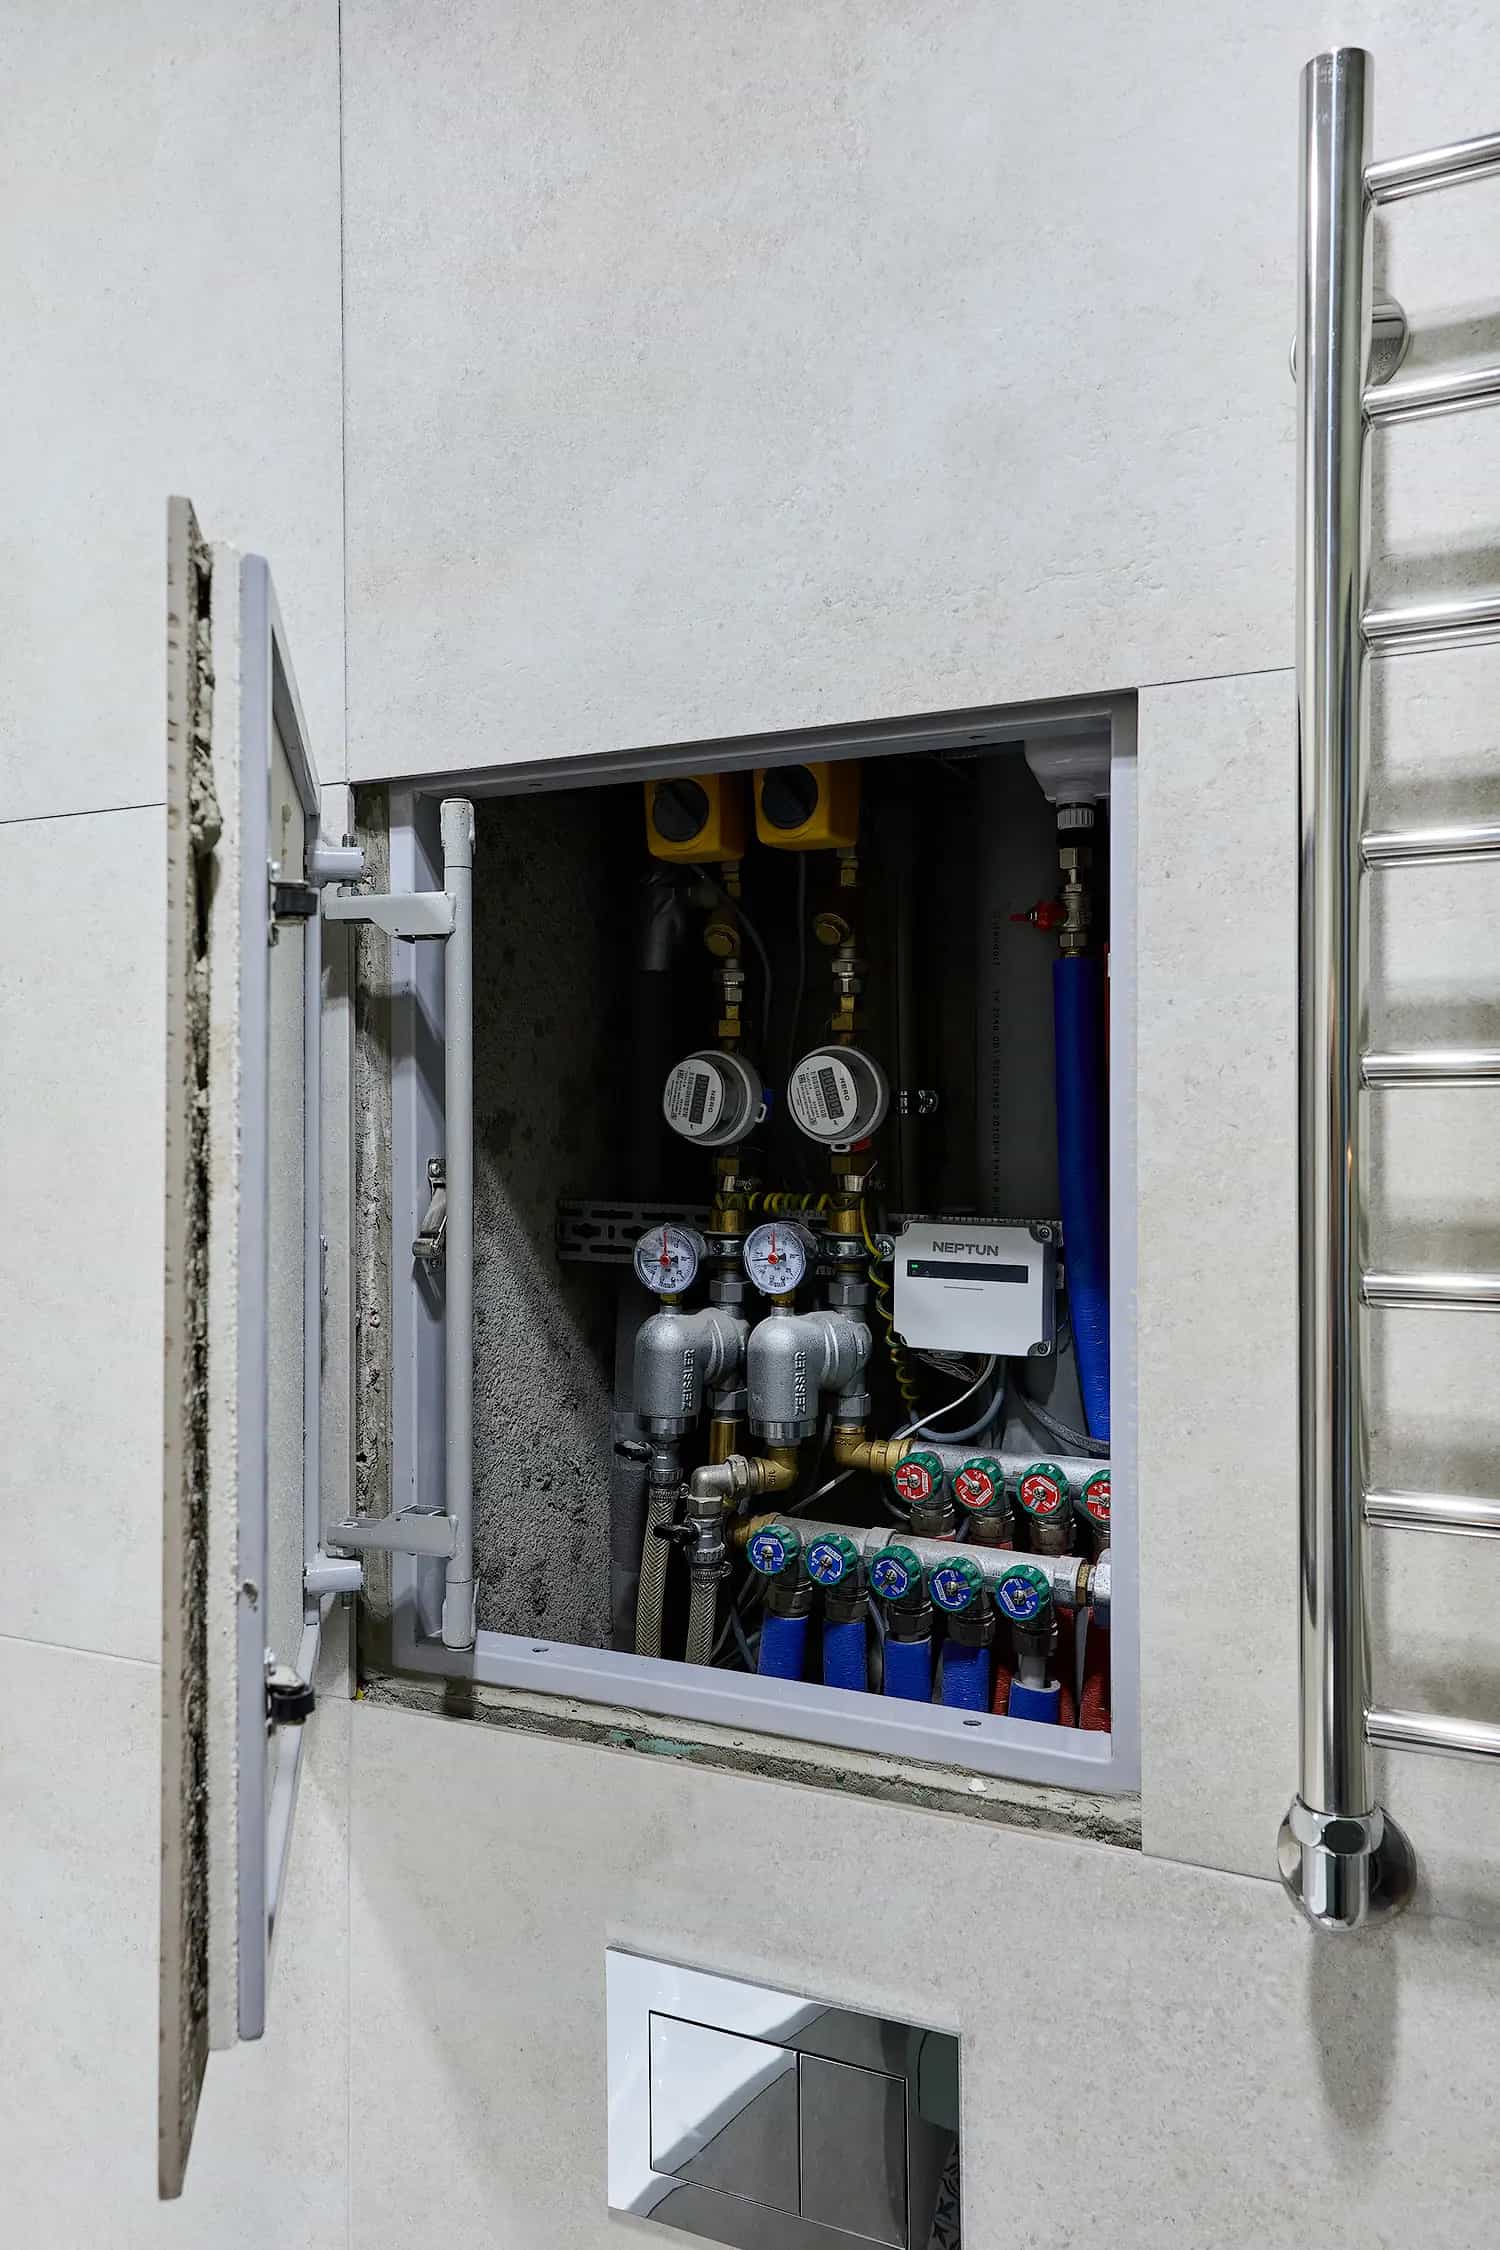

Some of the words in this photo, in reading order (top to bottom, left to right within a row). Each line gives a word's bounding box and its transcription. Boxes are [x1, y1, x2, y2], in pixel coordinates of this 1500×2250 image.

[932, 1240, 999, 1257] NEPTUN
[681, 1349, 696, 1411] ZEISSLER
[794, 1351, 807, 1417] ZEISSLER
